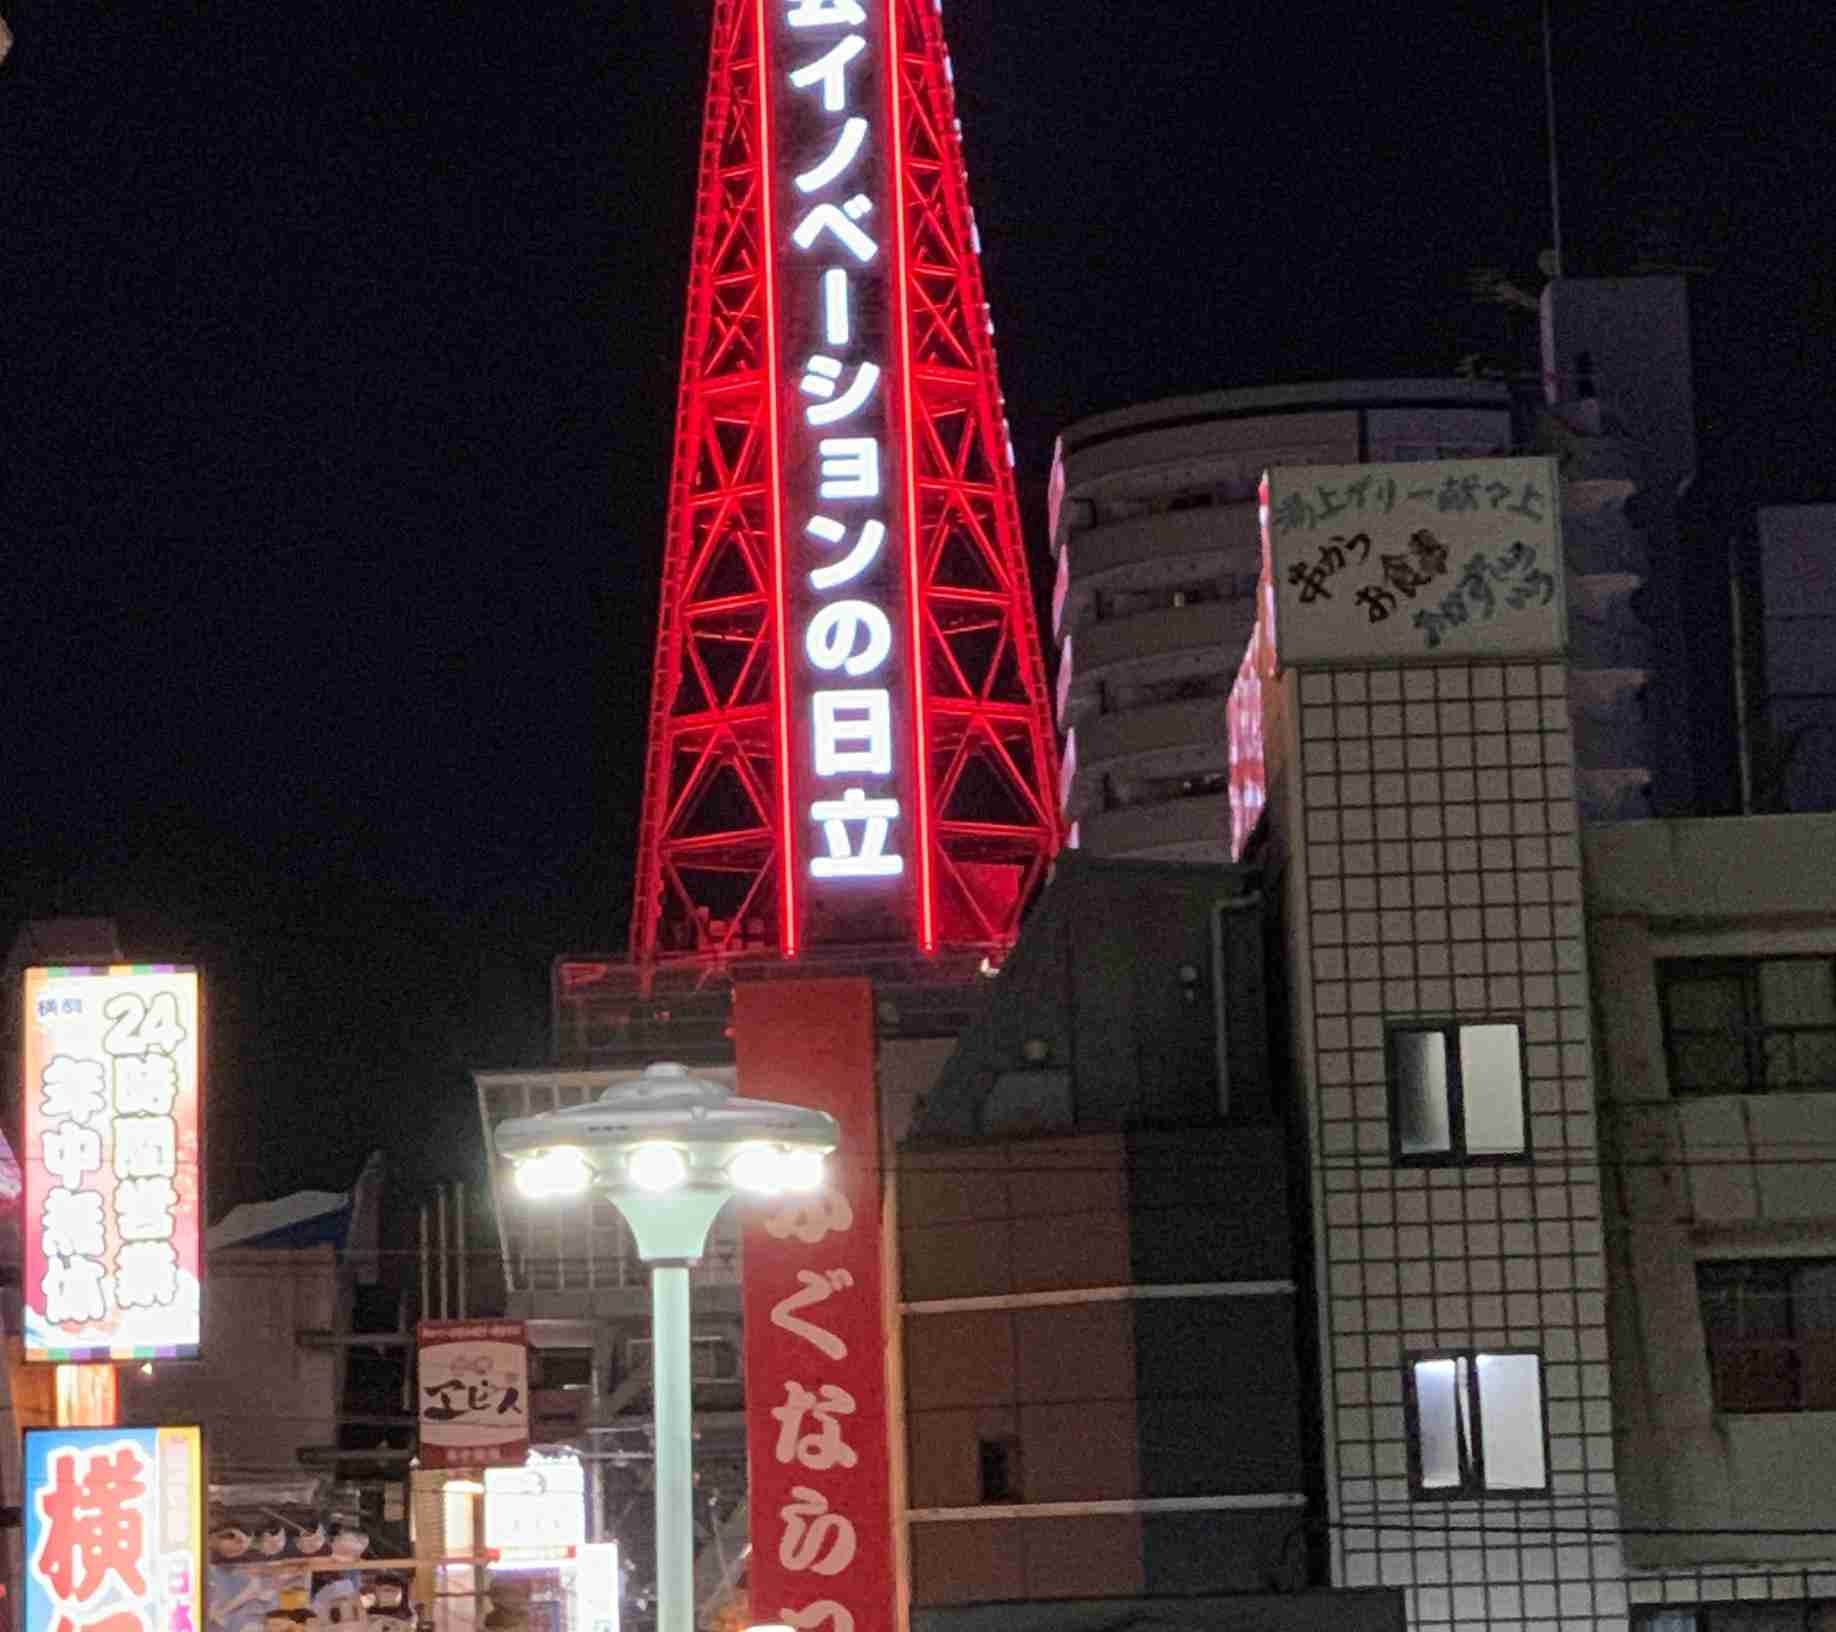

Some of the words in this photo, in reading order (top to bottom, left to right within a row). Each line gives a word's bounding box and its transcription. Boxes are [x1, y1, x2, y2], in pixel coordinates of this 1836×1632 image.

[422, 1378, 523, 1421] エビス
[39, 1448, 146, 1632] 横
